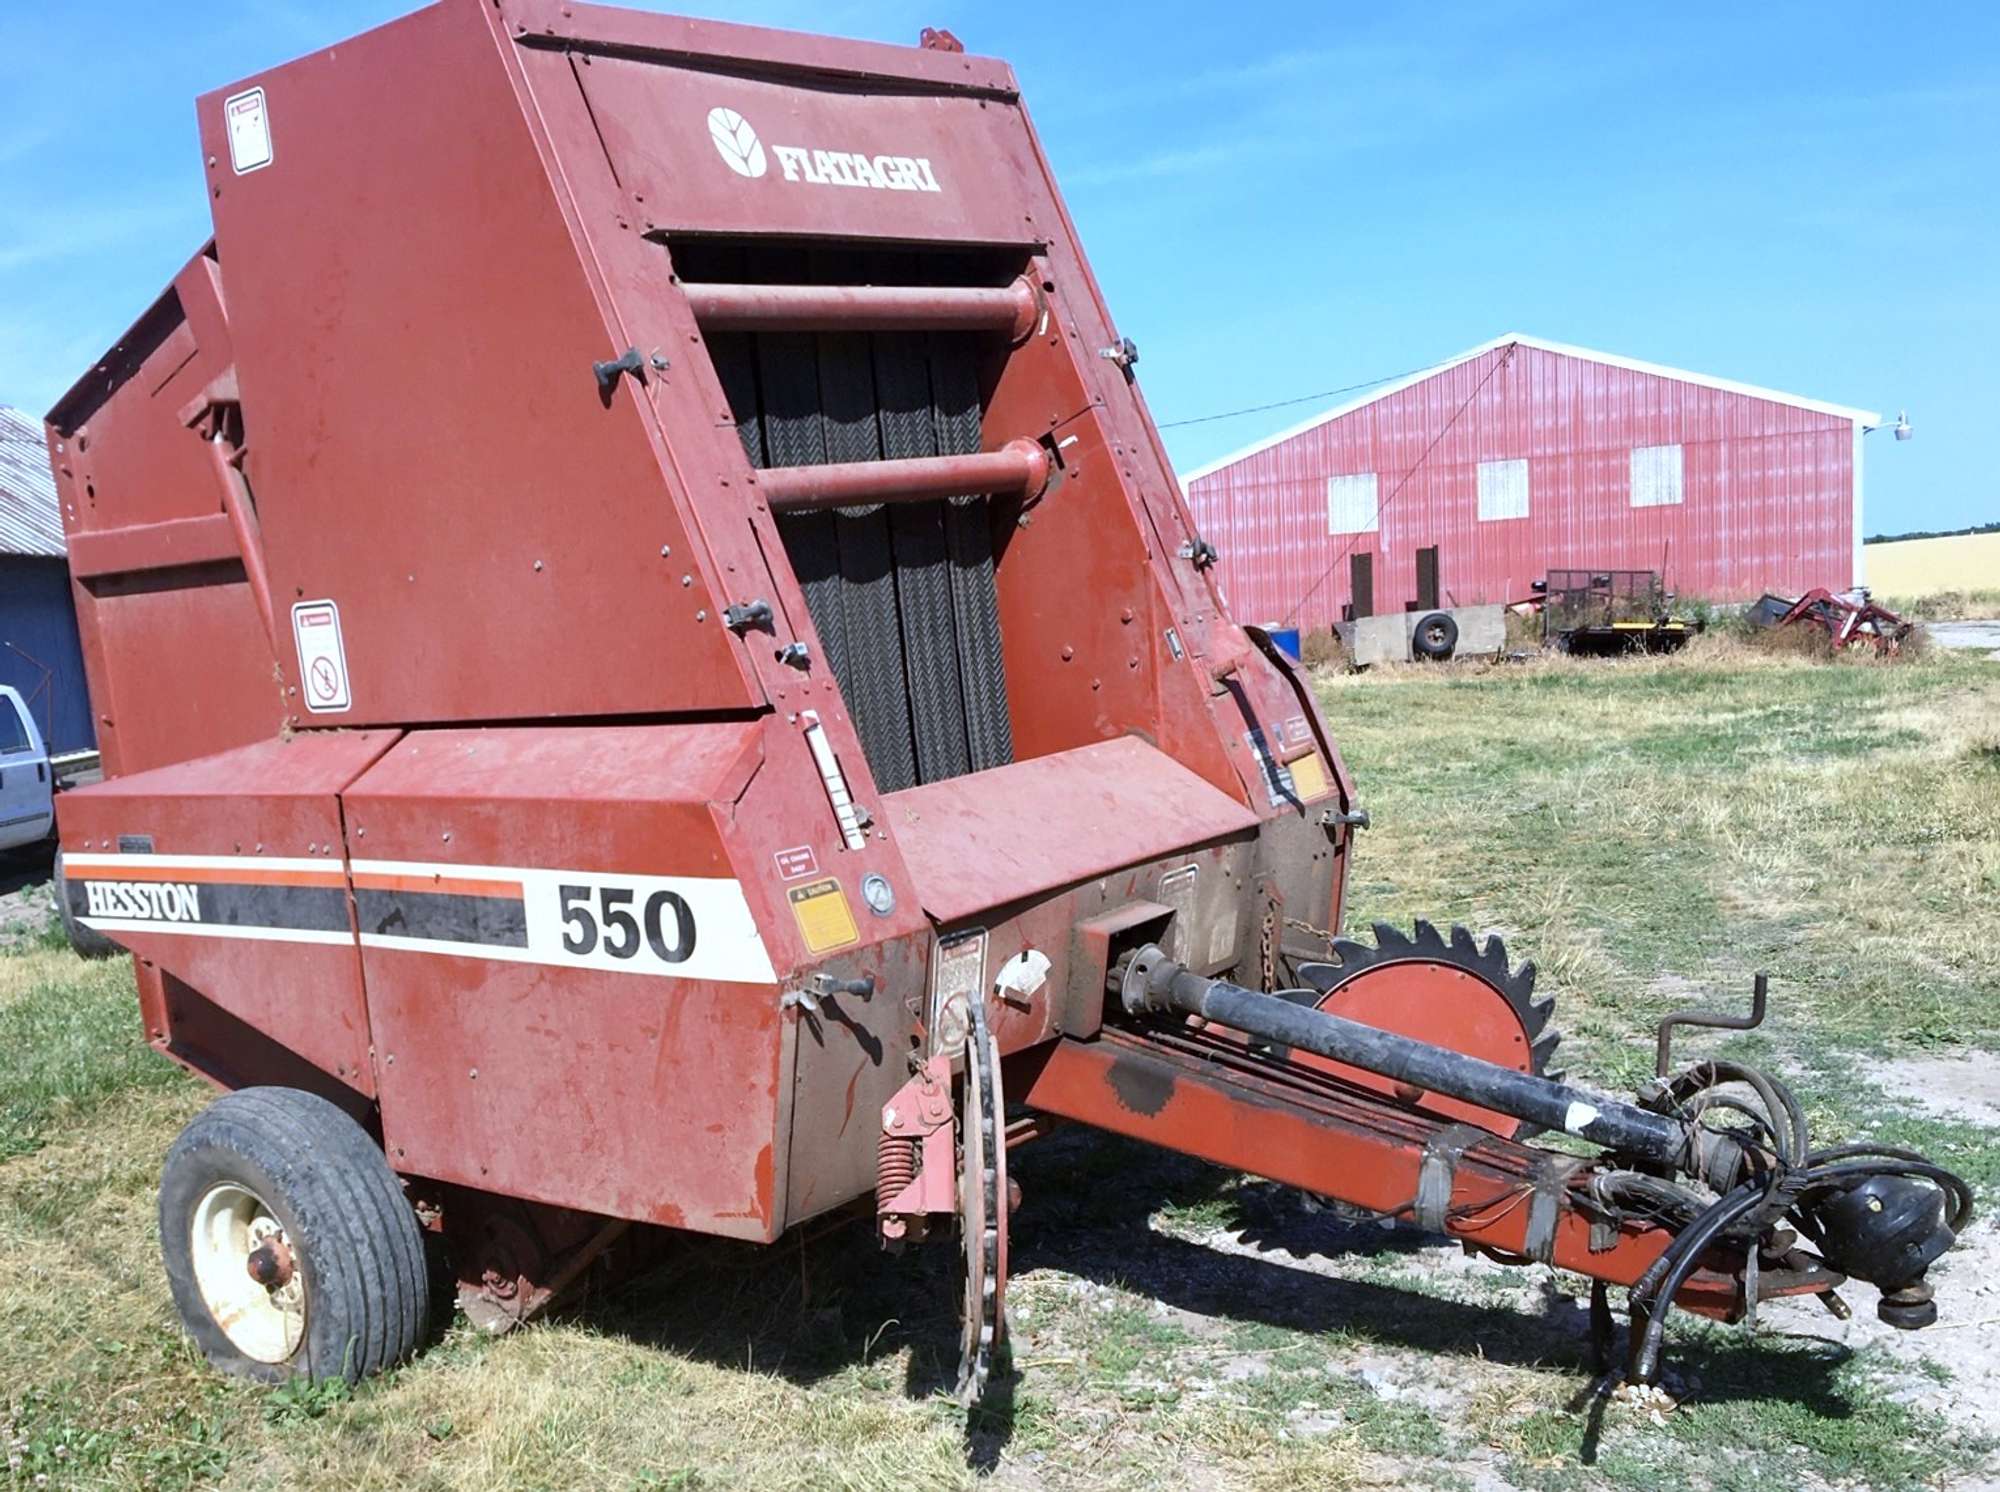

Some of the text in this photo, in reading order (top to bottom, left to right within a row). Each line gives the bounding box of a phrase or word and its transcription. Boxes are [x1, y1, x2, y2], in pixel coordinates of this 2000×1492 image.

[772, 145, 941, 192] FIATAGRI
[84, 880, 201, 921] HESSTON
[558, 884, 697, 964] 550
